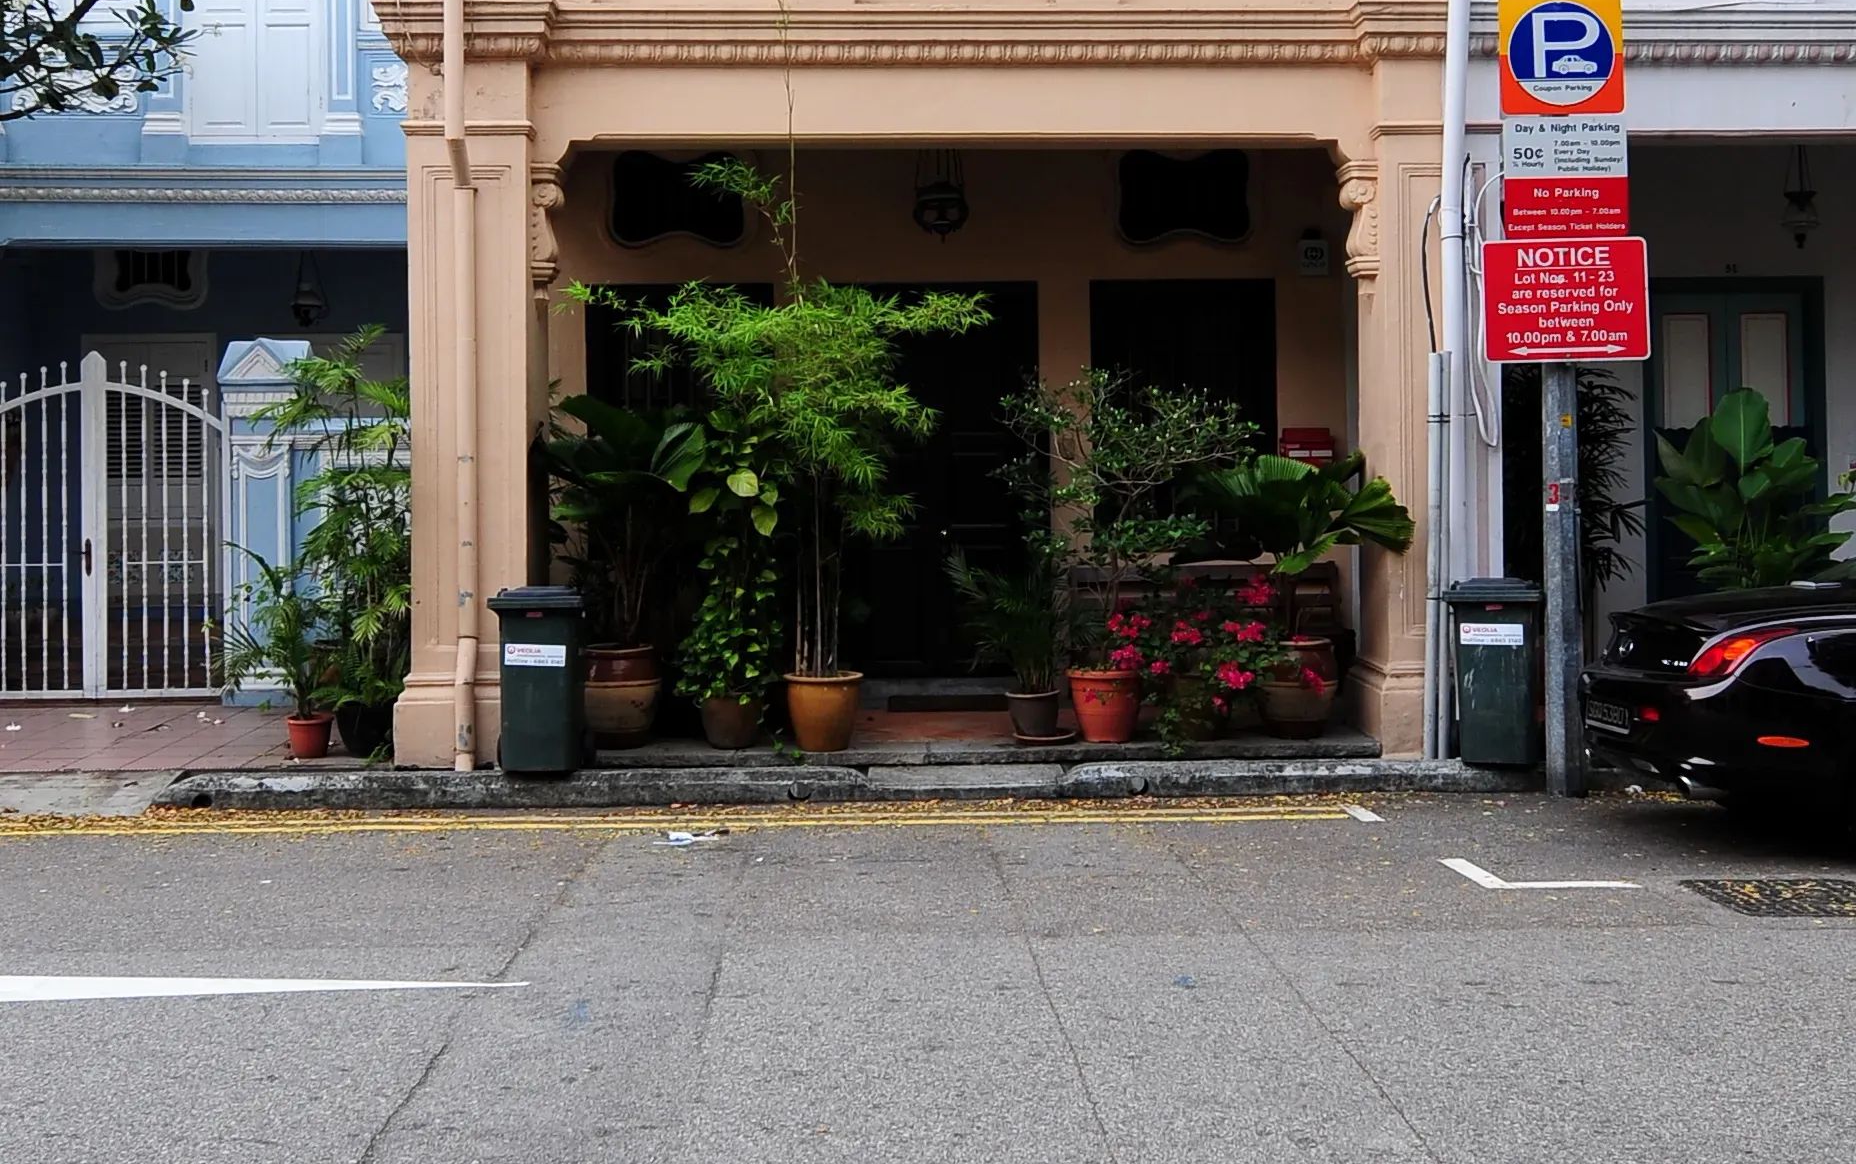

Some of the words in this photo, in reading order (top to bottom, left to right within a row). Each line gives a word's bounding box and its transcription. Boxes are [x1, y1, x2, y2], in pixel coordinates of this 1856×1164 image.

[1532, 12, 1600, 77] P
[1533, 84, 1562, 92] Coupon
[1565, 84, 1593, 92] Parking
[1515, 124, 1534, 135] Day
[1539, 124, 1546, 133] &
[1551, 124, 1577, 134] Night
[1582, 122, 1620, 134] Parking
[1590, 139, 1621, 147] 10.00pm
[1513, 147, 1544, 160] 50¢
[1554, 148, 1574, 156] Every
[1577, 148, 1591, 156] Day
[1582, 165, 1612, 173] Holiday)
[1534, 188, 1550, 198] No
[1555, 187, 1600, 199] Parking
[1513, 208, 1547, 216] Between
[1550, 207, 1583, 216] 10.00pm
[1592, 207, 1621, 215] 7.00am
[1508, 223, 1535, 232] Except
[1538, 222, 1567, 231] Season
[1570, 222, 1593, 230] Ticket
[1595, 221, 1626, 230] Holders
[1517, 246, 1611, 267] NOTICE
[1514, 272, 1536, 284] Lot
[1539, 272, 1569, 285] Nos.
[1573, 271, 1587, 283] 11
[1597, 271, 1615, 282] 23
[1512, 288, 1533, 299] are
[1536, 286, 1595, 298] reserved
[1599, 285, 1619, 297] for
[1498, 302, 1547, 314] Season
[1550, 300, 1600, 314] Parking
[1603, 299, 1633, 314] Only
[1538, 317, 1595, 328] between
[1506, 331, 1562, 345] 10.00pm
[1566, 331, 1576, 342] &
[1580, 329, 1628, 341] 7.00am
